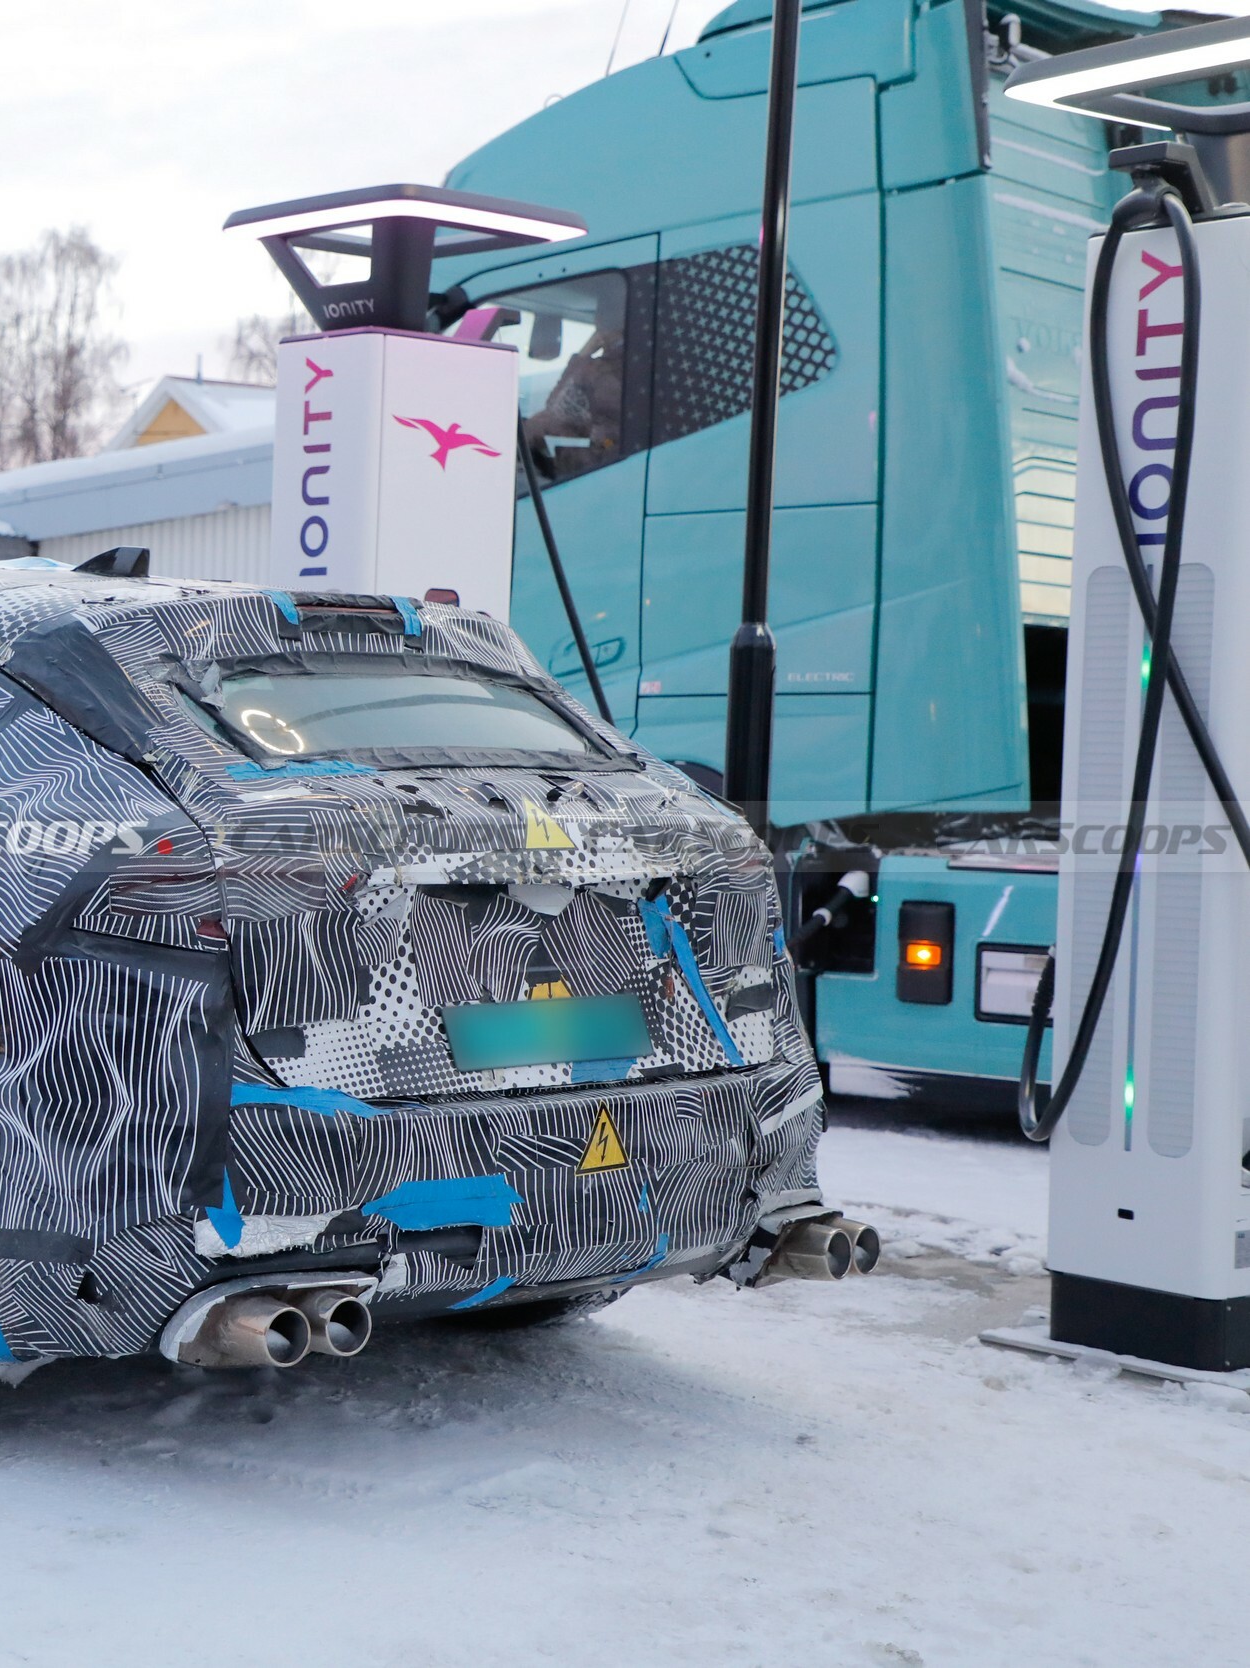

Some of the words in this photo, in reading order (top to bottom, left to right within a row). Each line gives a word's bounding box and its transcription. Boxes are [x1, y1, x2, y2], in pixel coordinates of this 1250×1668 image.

[322, 299, 374, 319] IONITY
[1128, 249, 1185, 546] IONITY
[298, 357, 334, 577] IONITY
[787, 672, 855, 682] ELECTRIC
